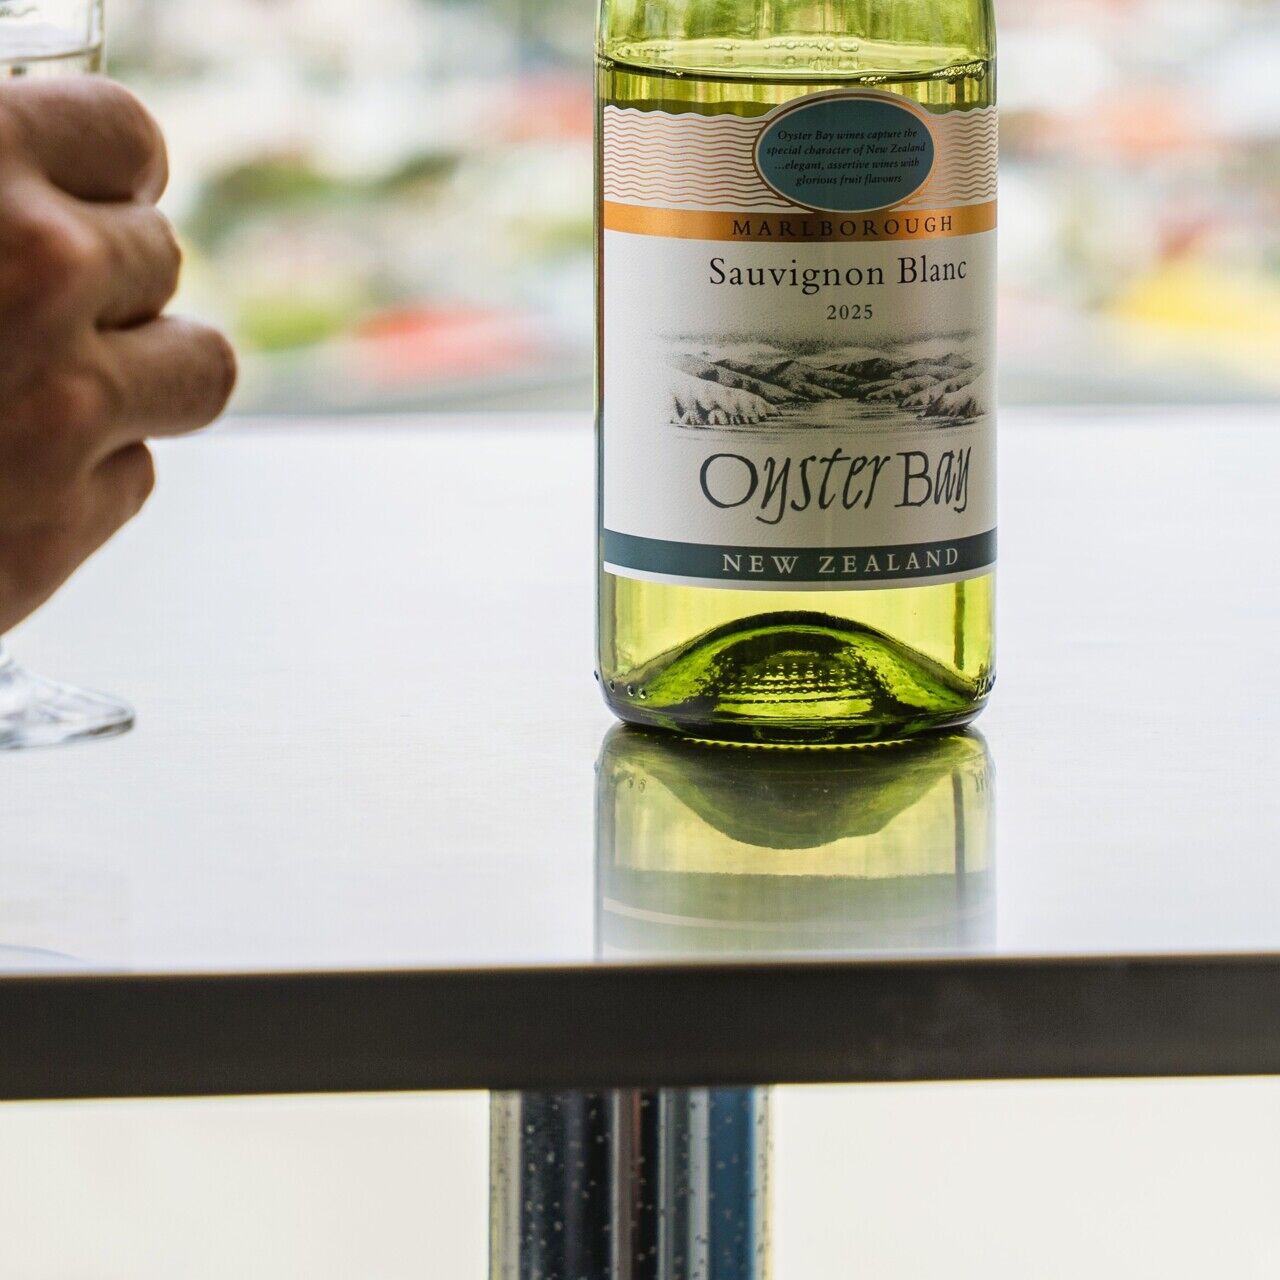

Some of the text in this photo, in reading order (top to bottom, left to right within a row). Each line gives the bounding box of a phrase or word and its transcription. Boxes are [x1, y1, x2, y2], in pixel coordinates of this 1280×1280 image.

[778, 129, 917, 141] Oyster Bay wines capture the
[767, 142, 925, 155] special character of New Zealand
[827, 160, 870, 169] assertive
[872, 160, 898, 168] wines
[900, 157, 919, 167] with
[796, 174, 902, 187] glorious fruit flavours
[732, 215, 953, 238] MARLBOROUGH
[709, 255, 967, 296] Sauvignon Blanc
[827, 304, 874, 320] 2025
[700, 447, 972, 525] Oyster Bay
[722, 548, 959, 575] NEW ZEALAND
